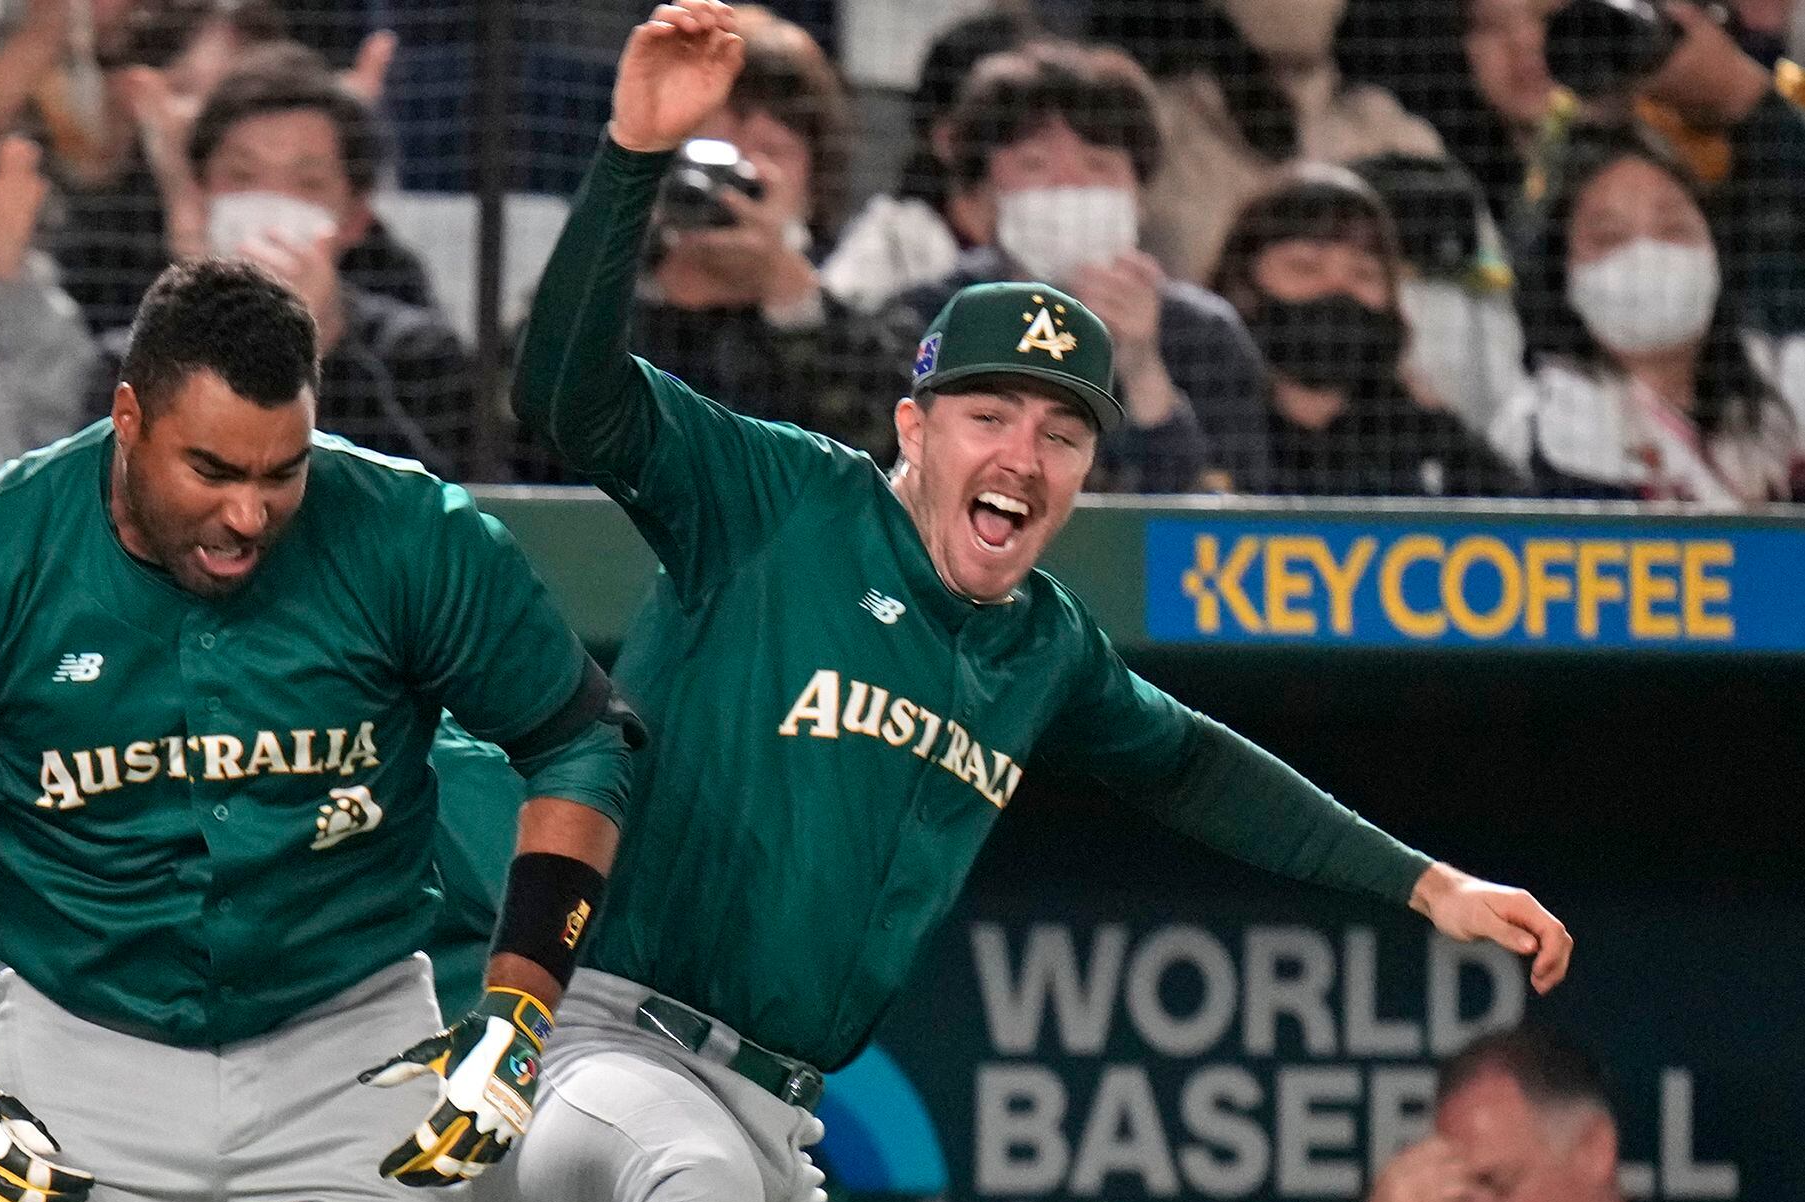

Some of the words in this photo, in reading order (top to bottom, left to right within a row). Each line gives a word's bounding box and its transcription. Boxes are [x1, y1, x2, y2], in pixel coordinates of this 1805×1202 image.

[35, 721, 381, 811] AUSTRALIA
[970, 922, 1527, 1058] WORLD
[974, 1064, 1740, 1199] BASEL
